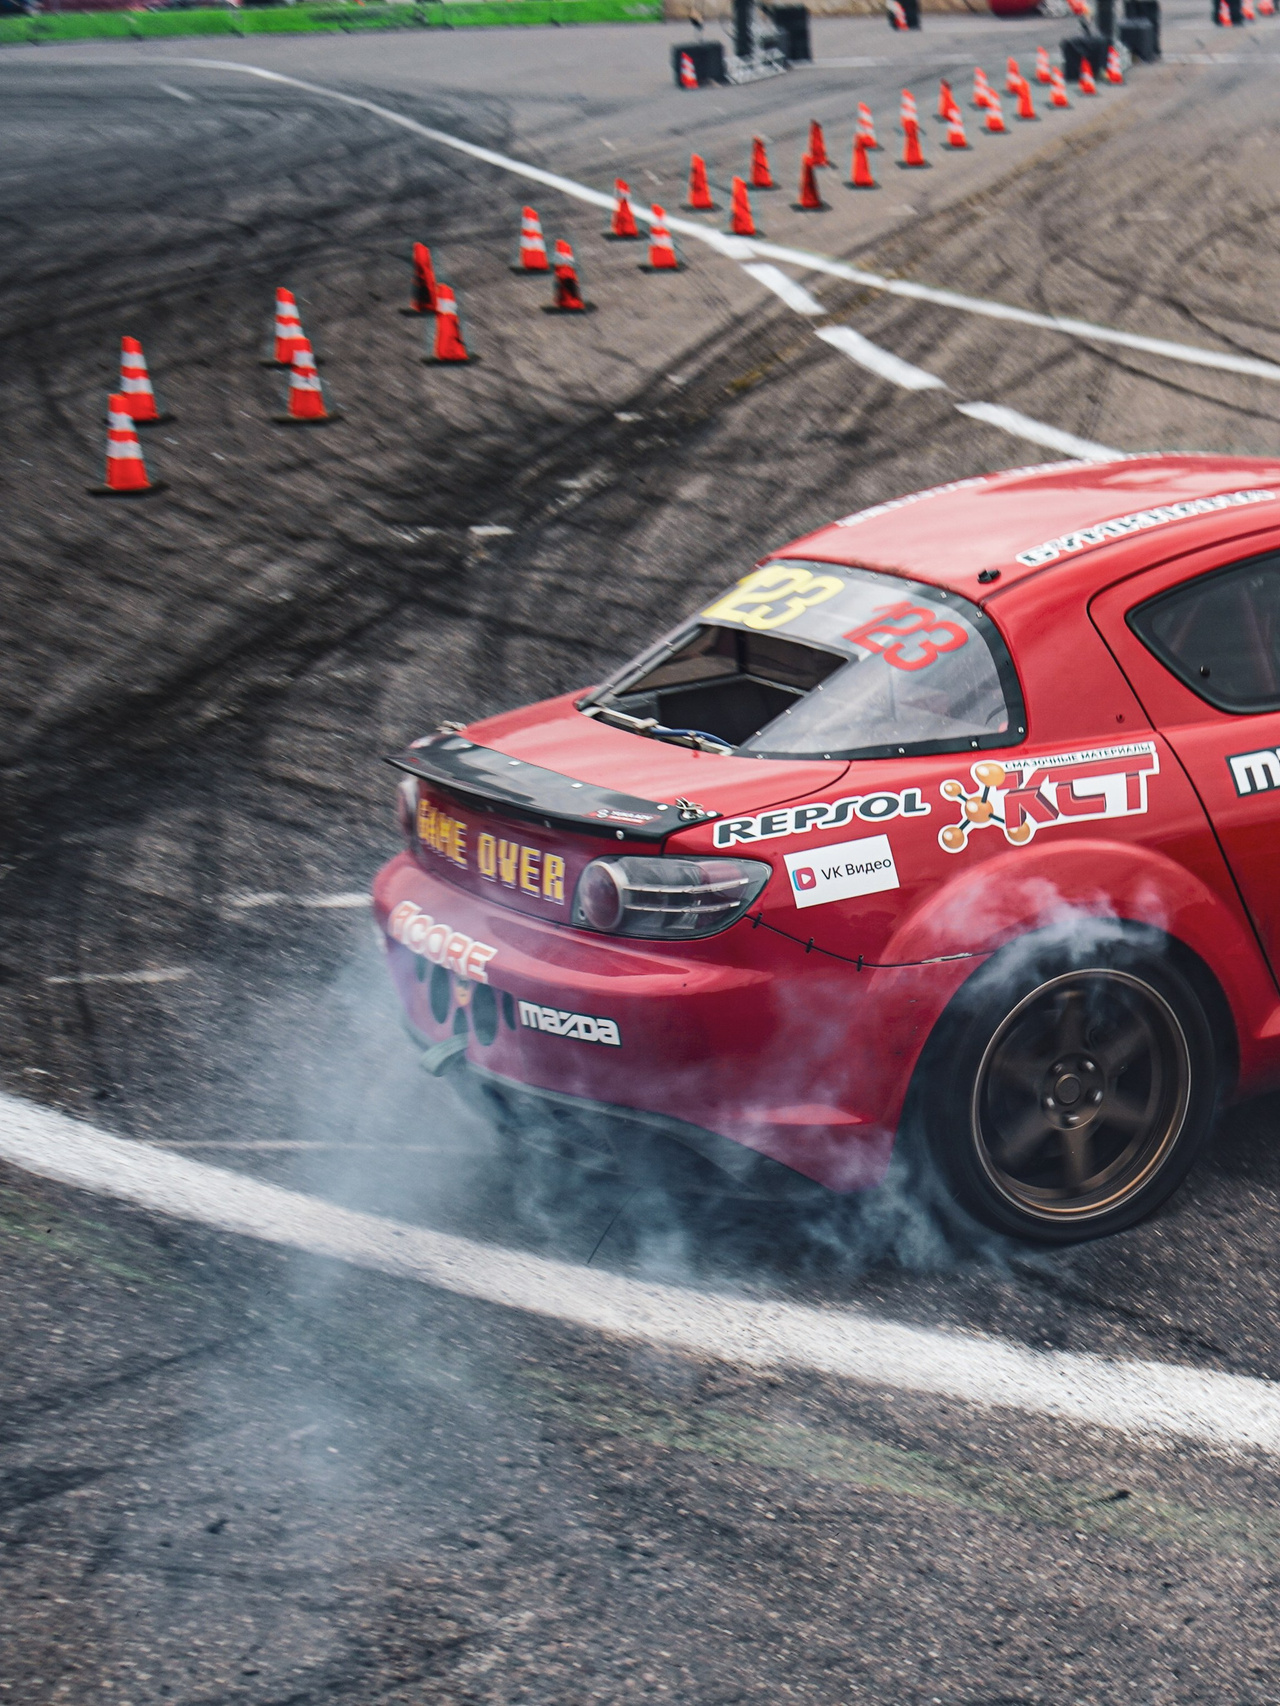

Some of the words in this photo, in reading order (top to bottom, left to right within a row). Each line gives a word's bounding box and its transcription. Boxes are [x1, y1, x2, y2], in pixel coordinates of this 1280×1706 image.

[1005, 754, 1079, 769] СМАЗОЧНЫЕ
[1081, 744, 1151, 761] МАТЕРИАЛЫ
[717, 792, 926, 845] REPSOL
[417, 799, 468, 870] GAME
[477, 832, 566, 906] OVER
[821, 865, 843, 880] VK
[845, 858, 892, 876] Видео
